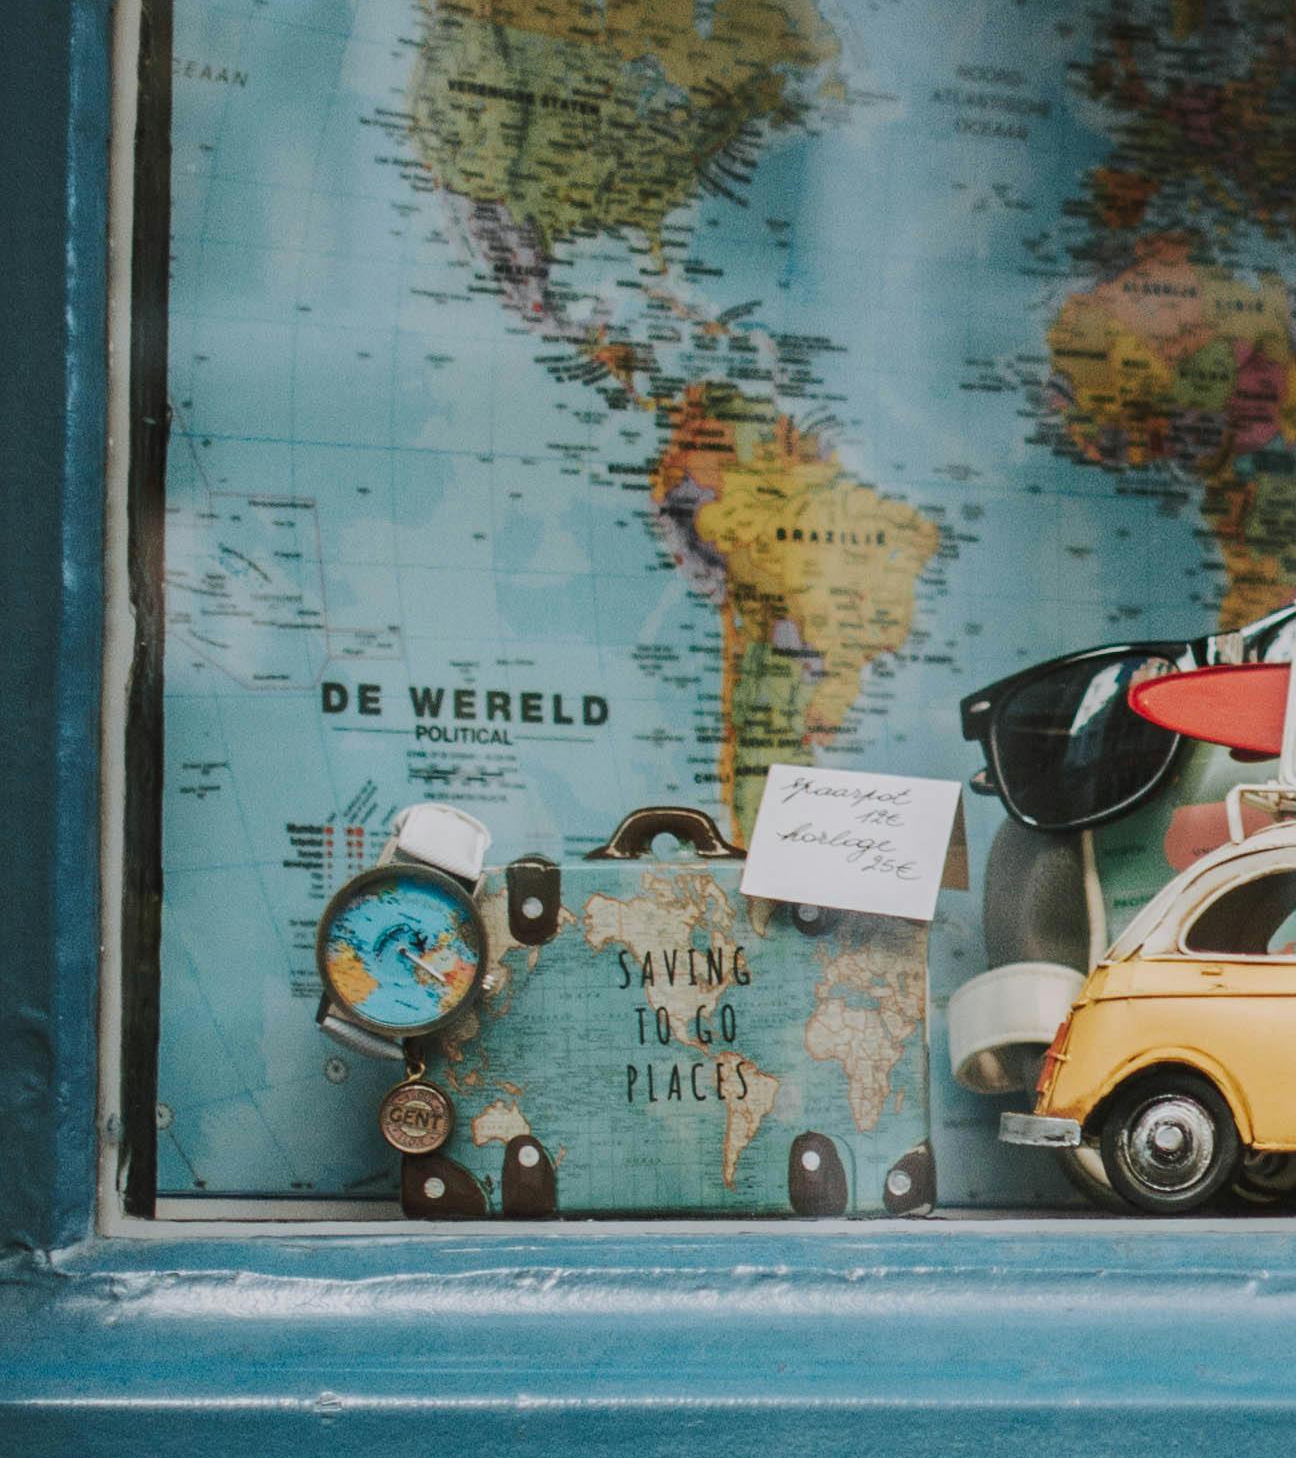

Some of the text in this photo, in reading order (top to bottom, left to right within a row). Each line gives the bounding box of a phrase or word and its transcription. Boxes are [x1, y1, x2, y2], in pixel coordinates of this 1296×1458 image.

[321, 682, 610, 727] DE WERELD
[415, 725, 514, 746] POLITICAL
[619, 946, 751, 989] SAVING
[636, 1003, 737, 1045] TO GO
[628, 1063, 750, 1104] PLACES
[388, 1105, 441, 1131] GENT
